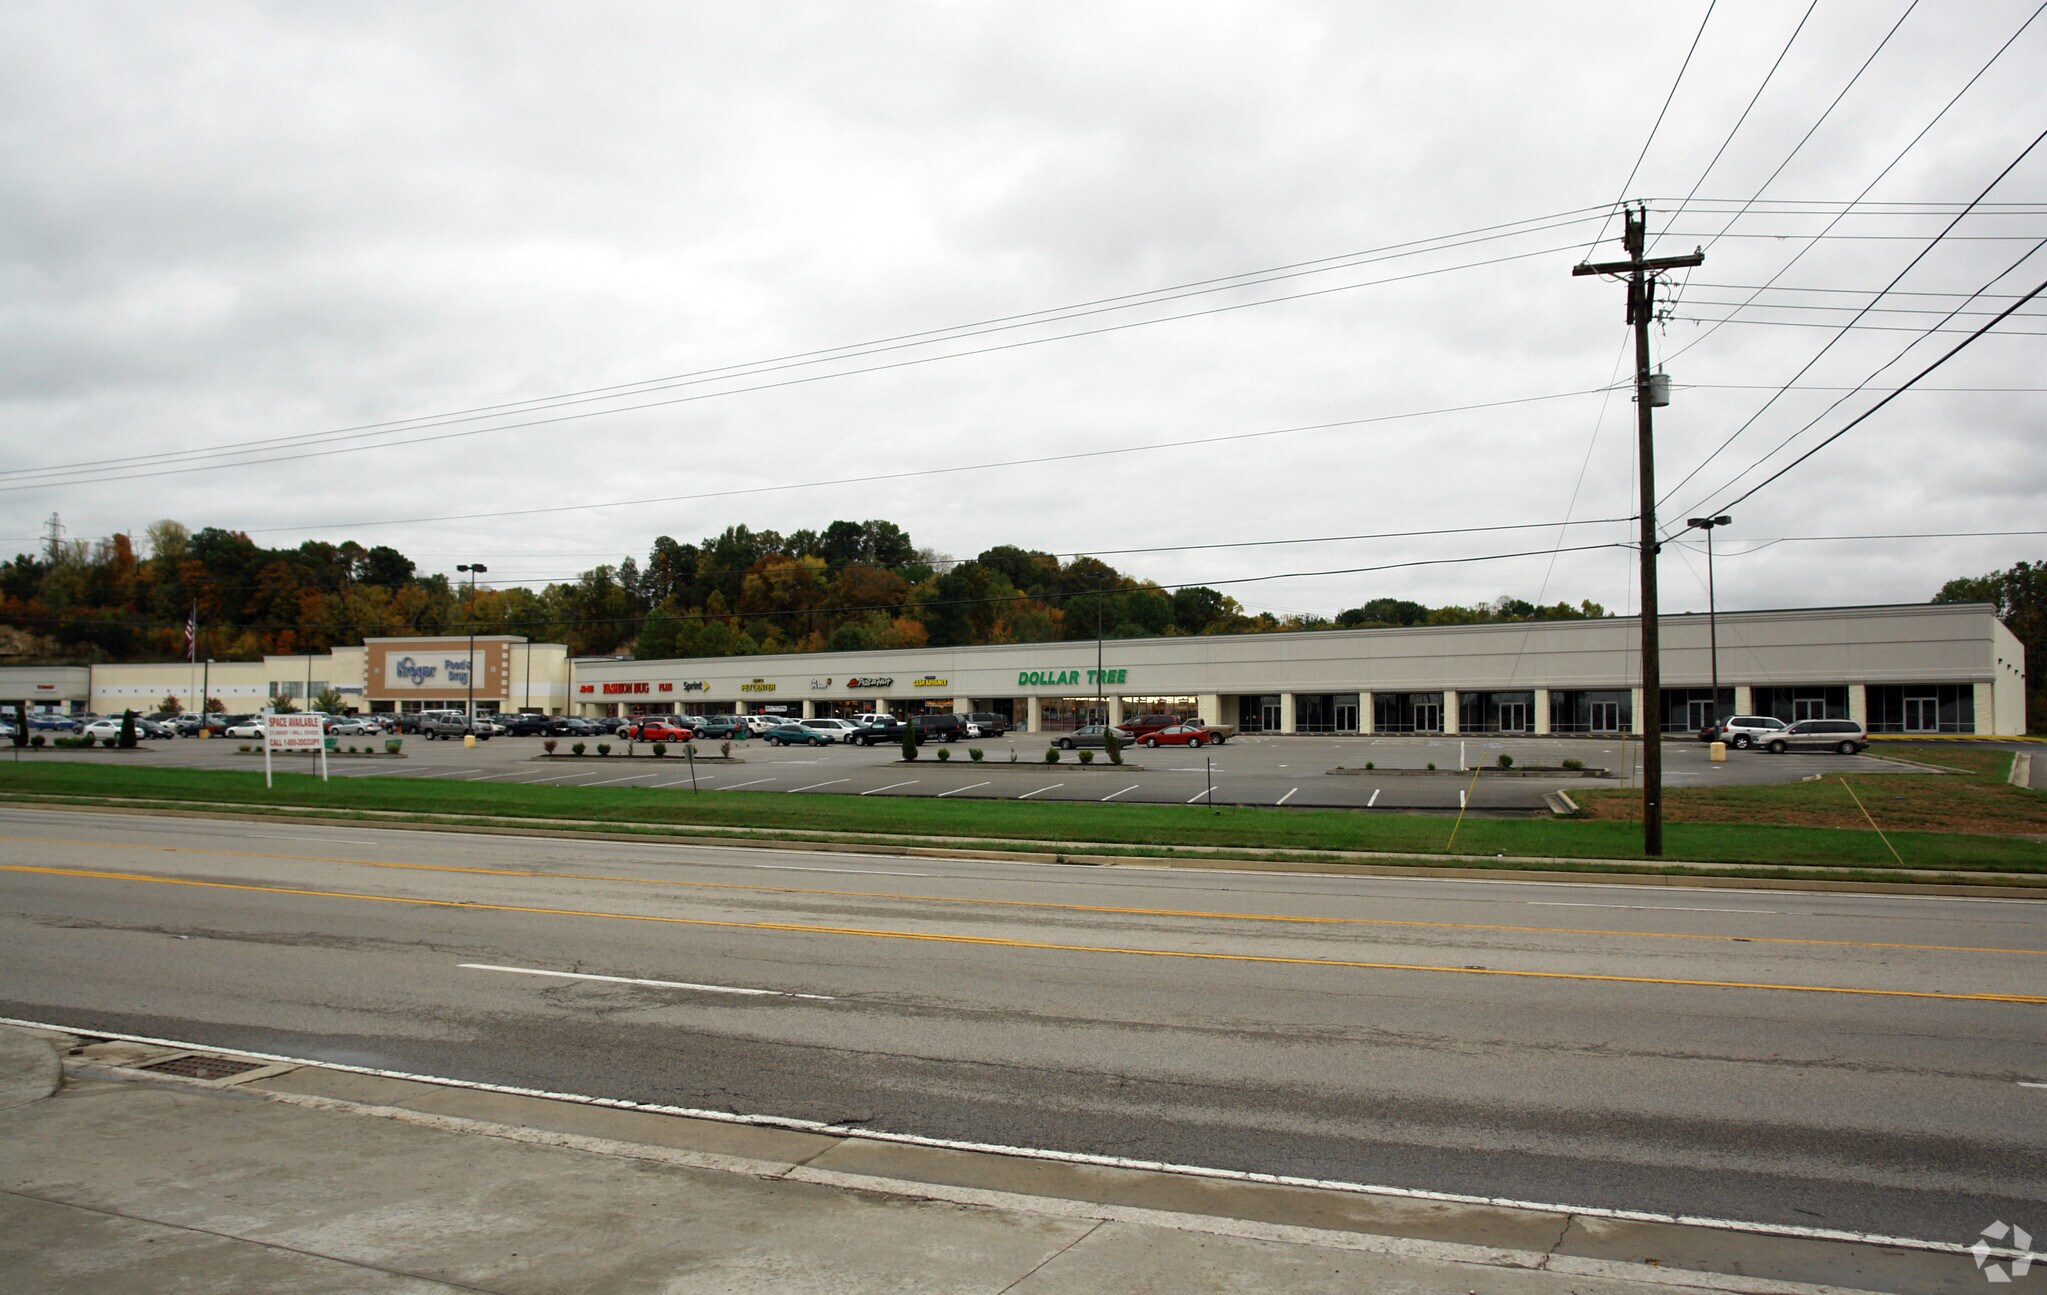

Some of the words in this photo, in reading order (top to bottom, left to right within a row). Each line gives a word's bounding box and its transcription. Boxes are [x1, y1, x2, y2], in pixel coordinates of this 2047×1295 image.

[396, 657, 436, 685] Kroger
[1018, 671, 1080, 686] DOLLAR
[1087, 669, 1127, 684] TREE
[603, 683, 632, 694] FASHION
[634, 682, 649, 694] BUG
[683, 681, 703, 692] Sprint
[269, 717, 287, 727] SPACE
[288, 717, 318, 727] AVAILABLE
[270, 738, 283, 747] CALL
